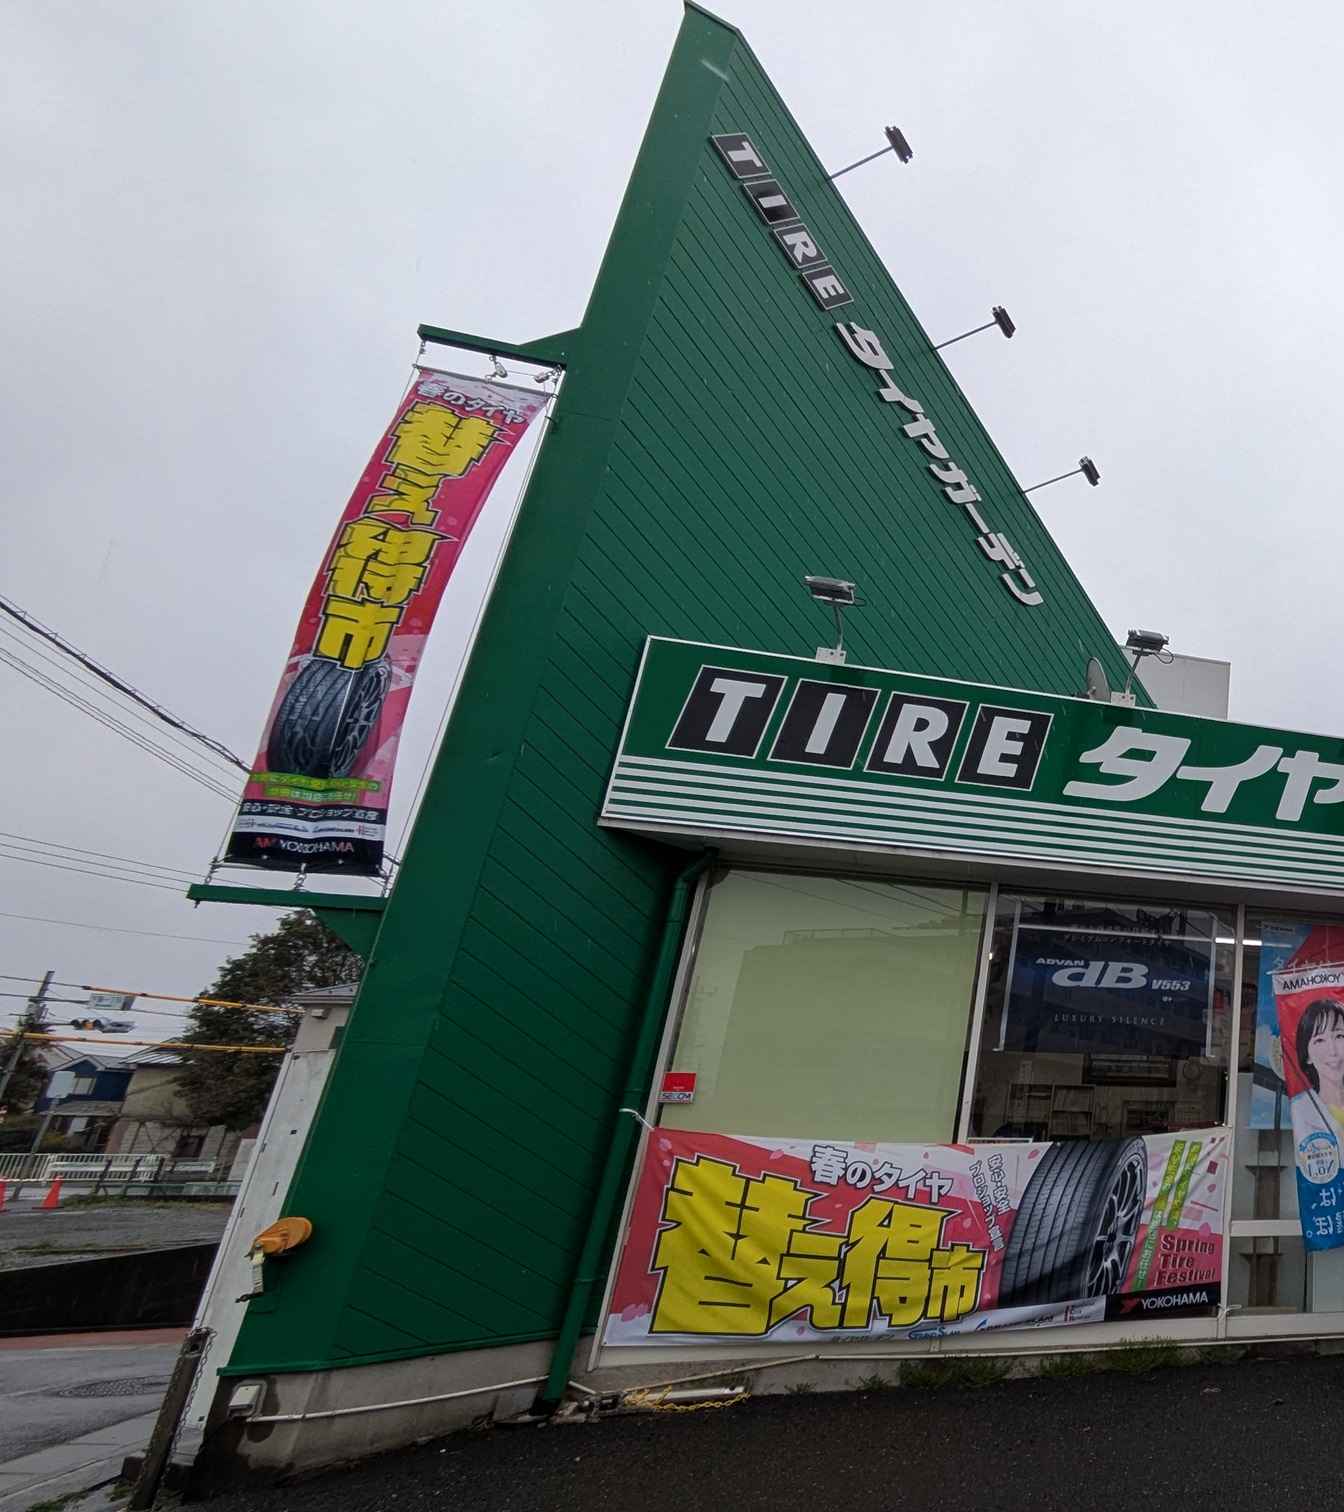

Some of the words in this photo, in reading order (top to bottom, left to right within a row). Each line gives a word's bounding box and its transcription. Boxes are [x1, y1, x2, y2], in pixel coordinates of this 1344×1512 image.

[726, 140, 846, 300] TIRE
[417, 380, 527, 425] 春のタイヤ
[835, 321, 1044, 606] タイヤガーデン
[706, 678, 1034, 778] TIRE
[279, 838, 354, 853] YOKOHAMA
[1035, 957, 1084, 966] ADVAN
[1052, 960, 1149, 989] dB
[1151, 979, 1191, 991] V553
[1054, 1013, 1103, 1023] LUXURY
[1112, 1015, 1165, 1025] SILENCE
[811, 1143, 954, 1206] 春のタイヤ
[1160, 1234, 1216, 1255] Spring
[1159, 1253, 1195, 1269] Tire
[1154, 1269, 1216, 1287] Festival
[1141, 1291, 1209, 1309] YOKOHAMA
